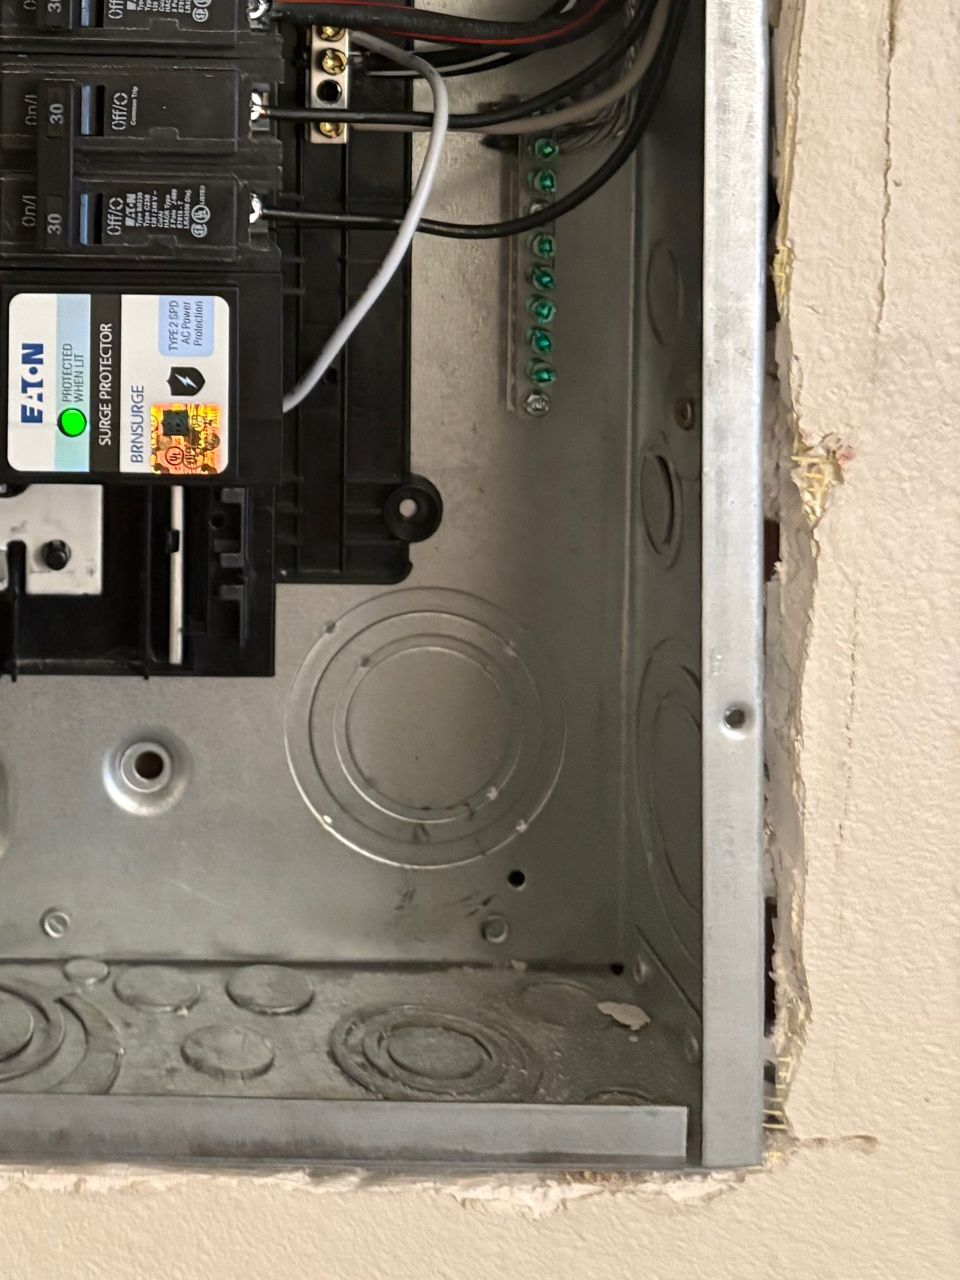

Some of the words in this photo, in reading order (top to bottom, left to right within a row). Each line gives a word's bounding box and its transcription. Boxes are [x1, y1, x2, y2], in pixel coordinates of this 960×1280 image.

[49, 103, 64, 124] 30
[47, 213, 63, 235] 30
[169, 300, 178, 320] SPD
[181, 301, 191, 333] Power
[193, 301, 203, 346] Protection
[168, 330, 178, 351] TYPE
[180, 333, 190, 345] AC
[62, 343, 73, 403] PROTECTED
[74, 353, 84, 366] LIT
[99, 323, 112, 398] PROTECTOR
[21, 343, 44, 424] EATON
[73, 367, 84, 403] WHEN
[99, 402, 112, 446] SURGE
[131, 385, 144, 464] BRNSURGE
